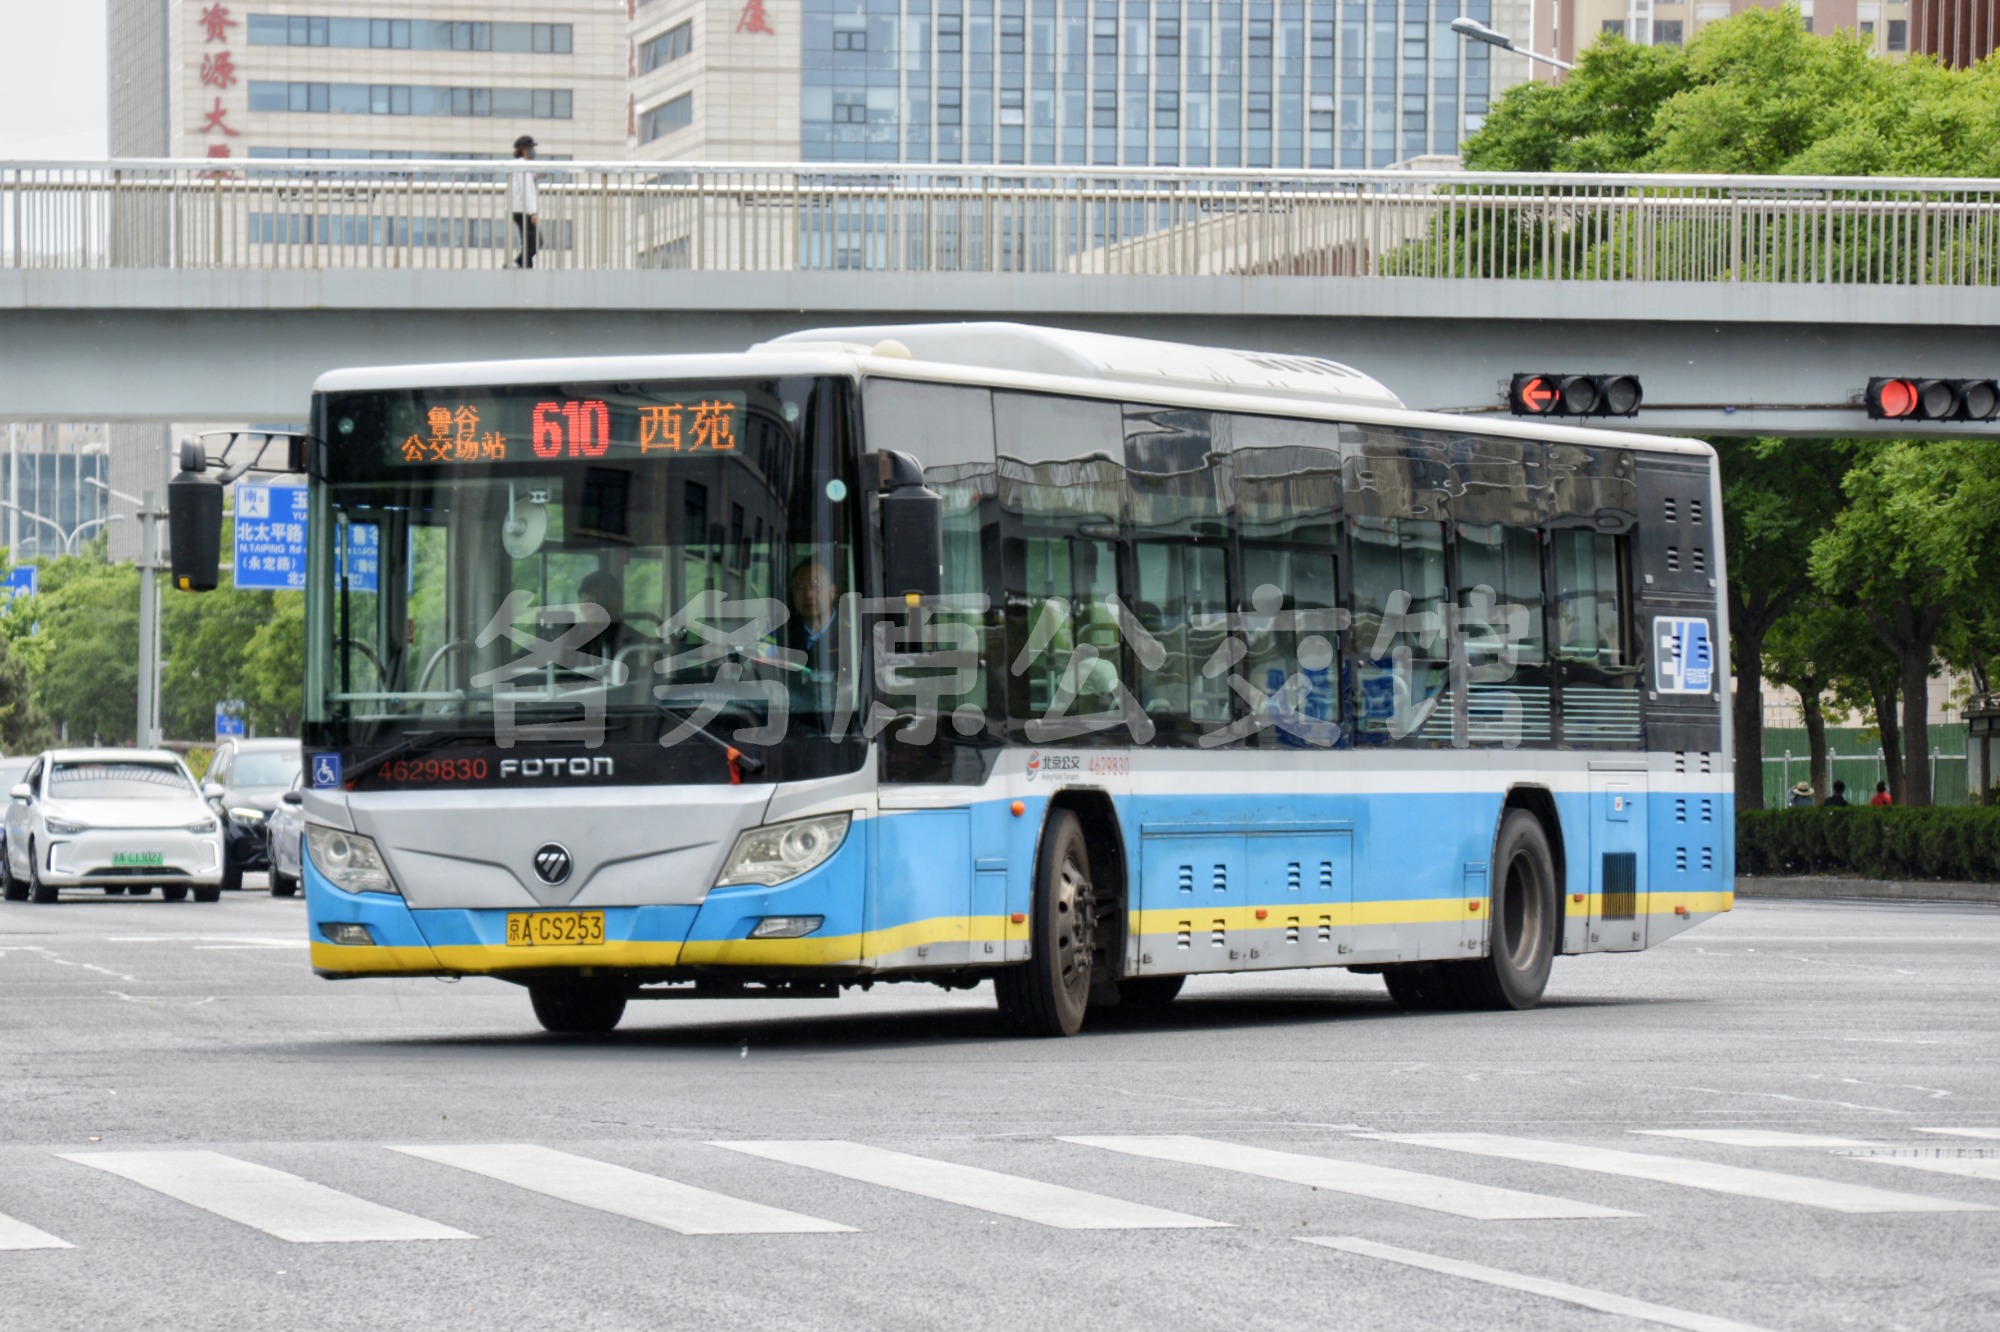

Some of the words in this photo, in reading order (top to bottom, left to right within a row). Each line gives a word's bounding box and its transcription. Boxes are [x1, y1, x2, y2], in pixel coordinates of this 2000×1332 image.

[533, 401, 608, 458] 610
[638, 400, 735, 454] 西苑
[401, 432, 507, 462] 公交场站
[238, 522, 302, 543] 北太平路
[378, 758, 488, 782] 4629830
[500, 757, 614, 778] FOTON
[1042, 755, 1080, 770] 北京公交
[1088, 755, 1130, 776] 4629830
